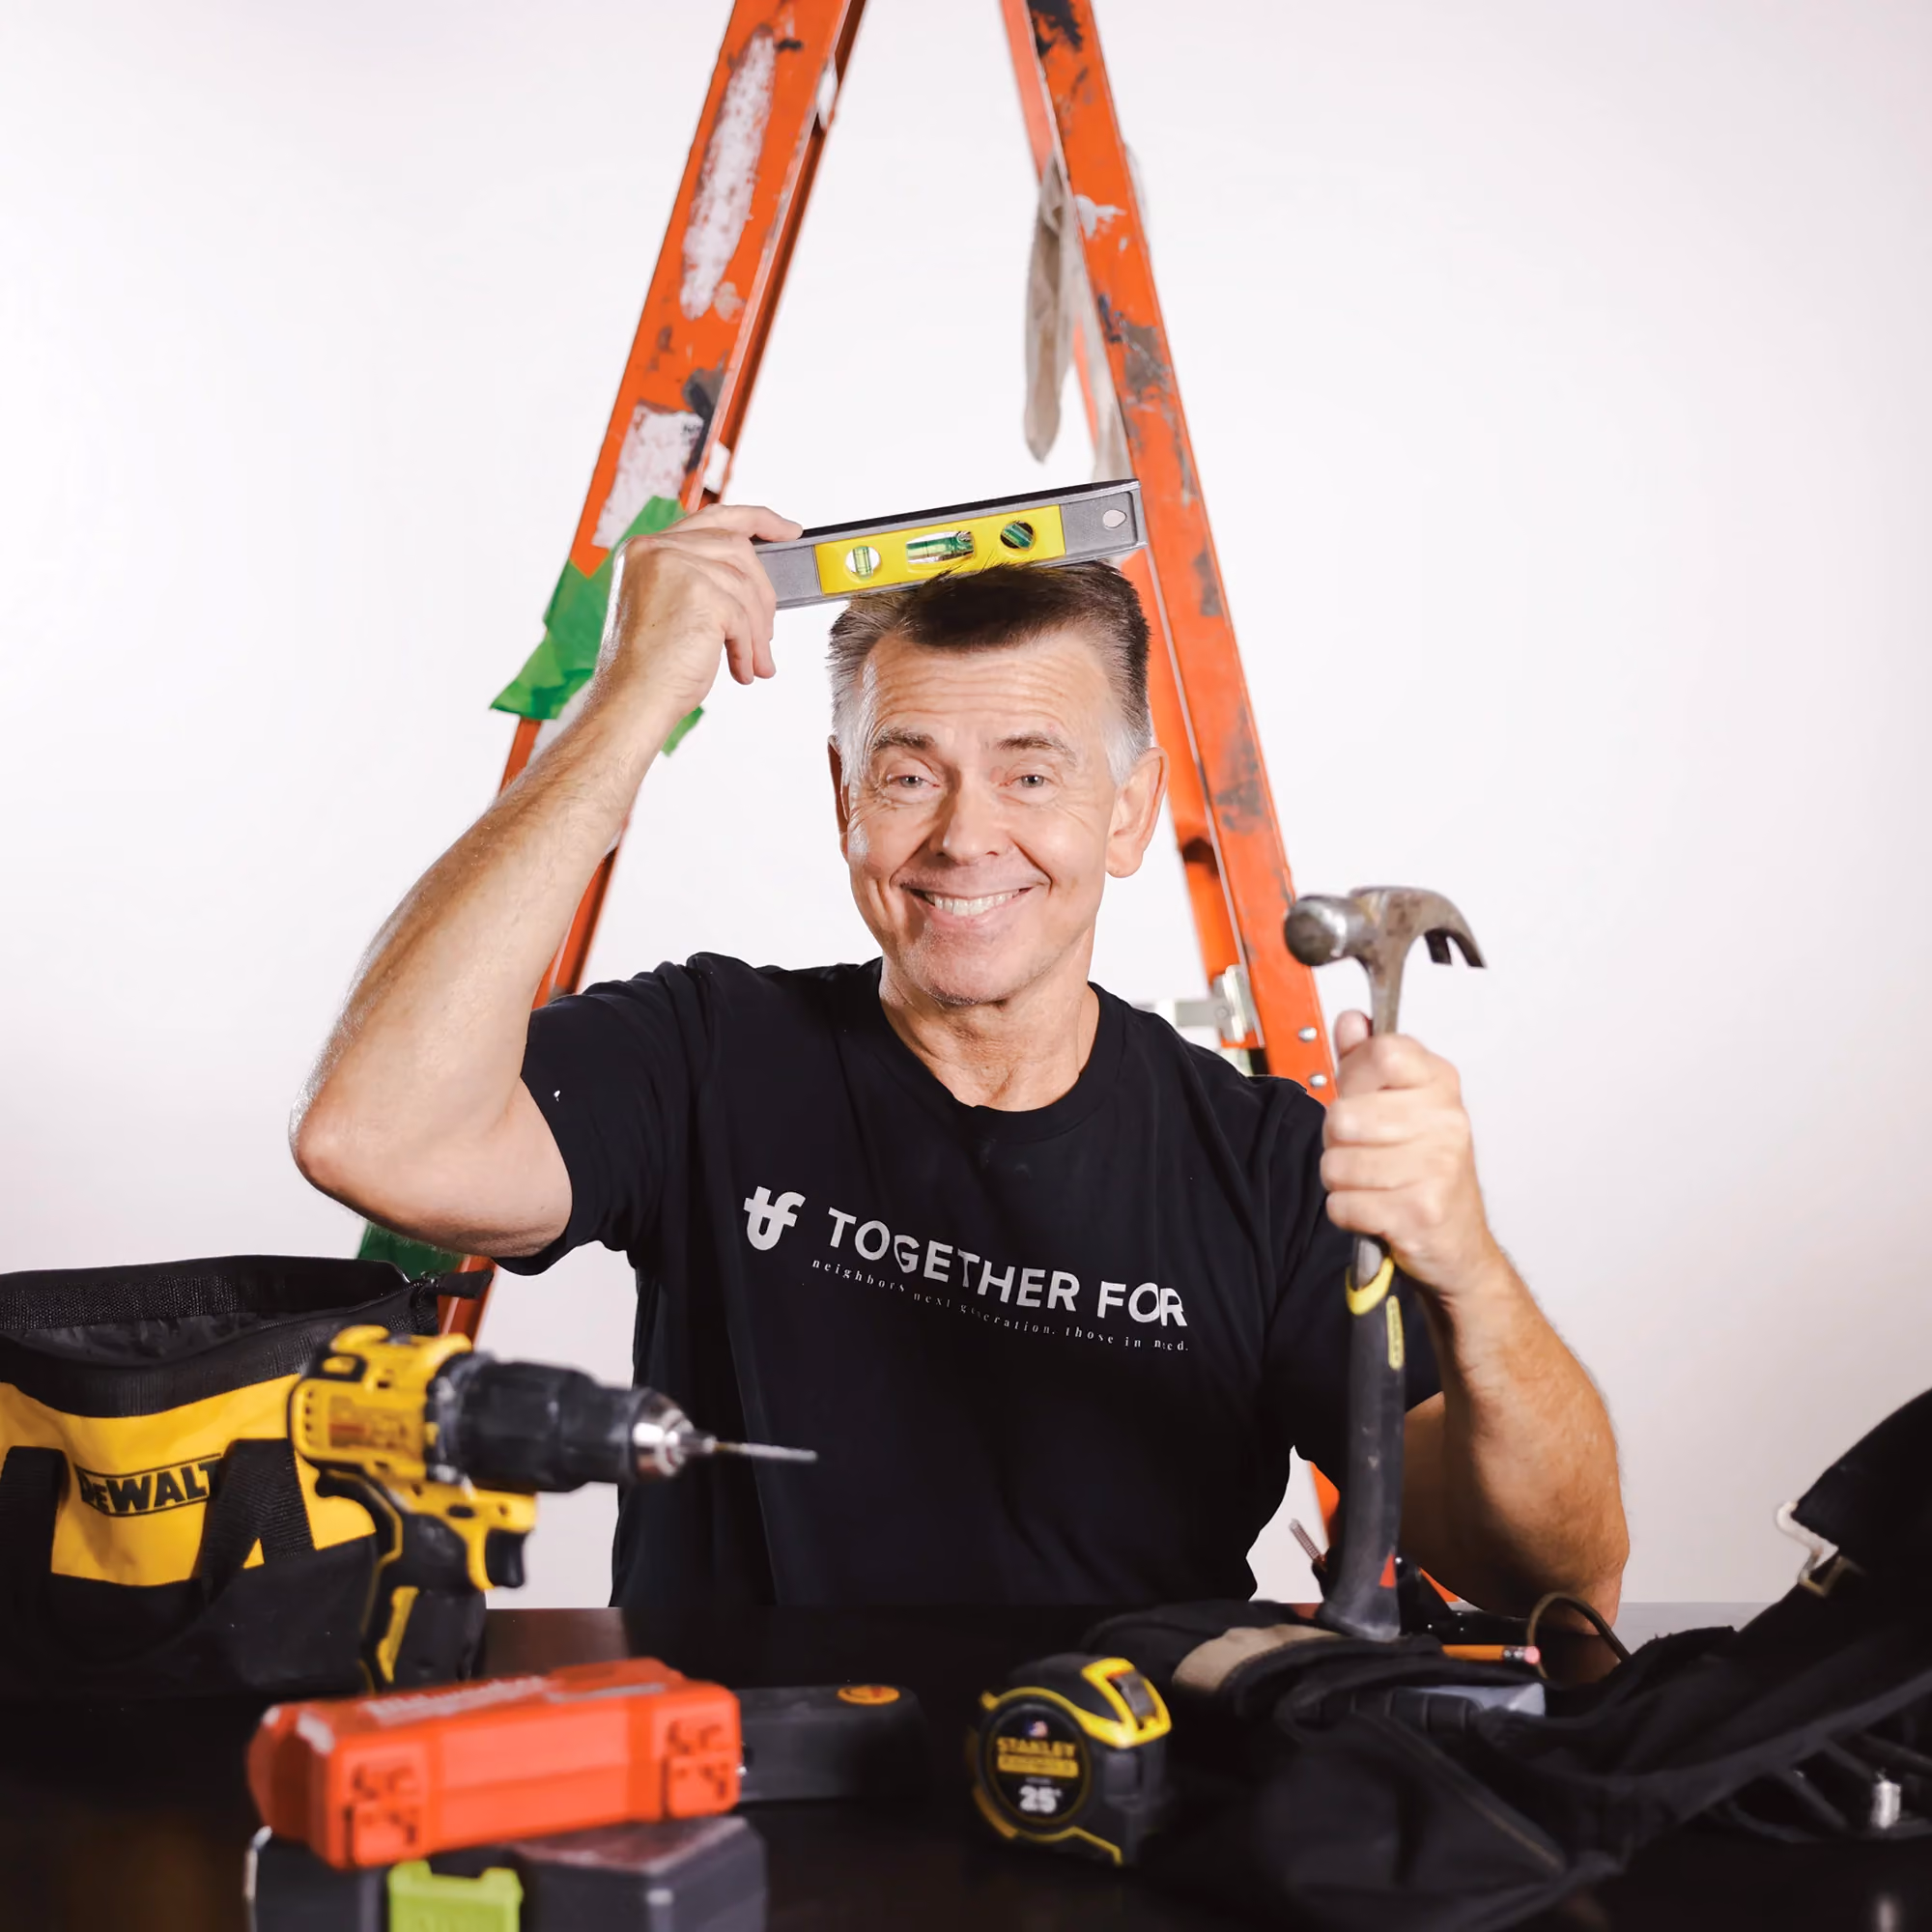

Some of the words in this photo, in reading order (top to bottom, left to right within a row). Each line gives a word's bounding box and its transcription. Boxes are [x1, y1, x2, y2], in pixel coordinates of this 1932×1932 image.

[811, 1259, 905, 1293] neighbors
[913, 1293, 951, 1308] next
[1065, 1326, 1114, 1344] those
[1124, 1336, 1142, 1348] in
[828, 1207, 1080, 1312] TOGETHER
[1096, 1280, 1188, 1327] FOR
